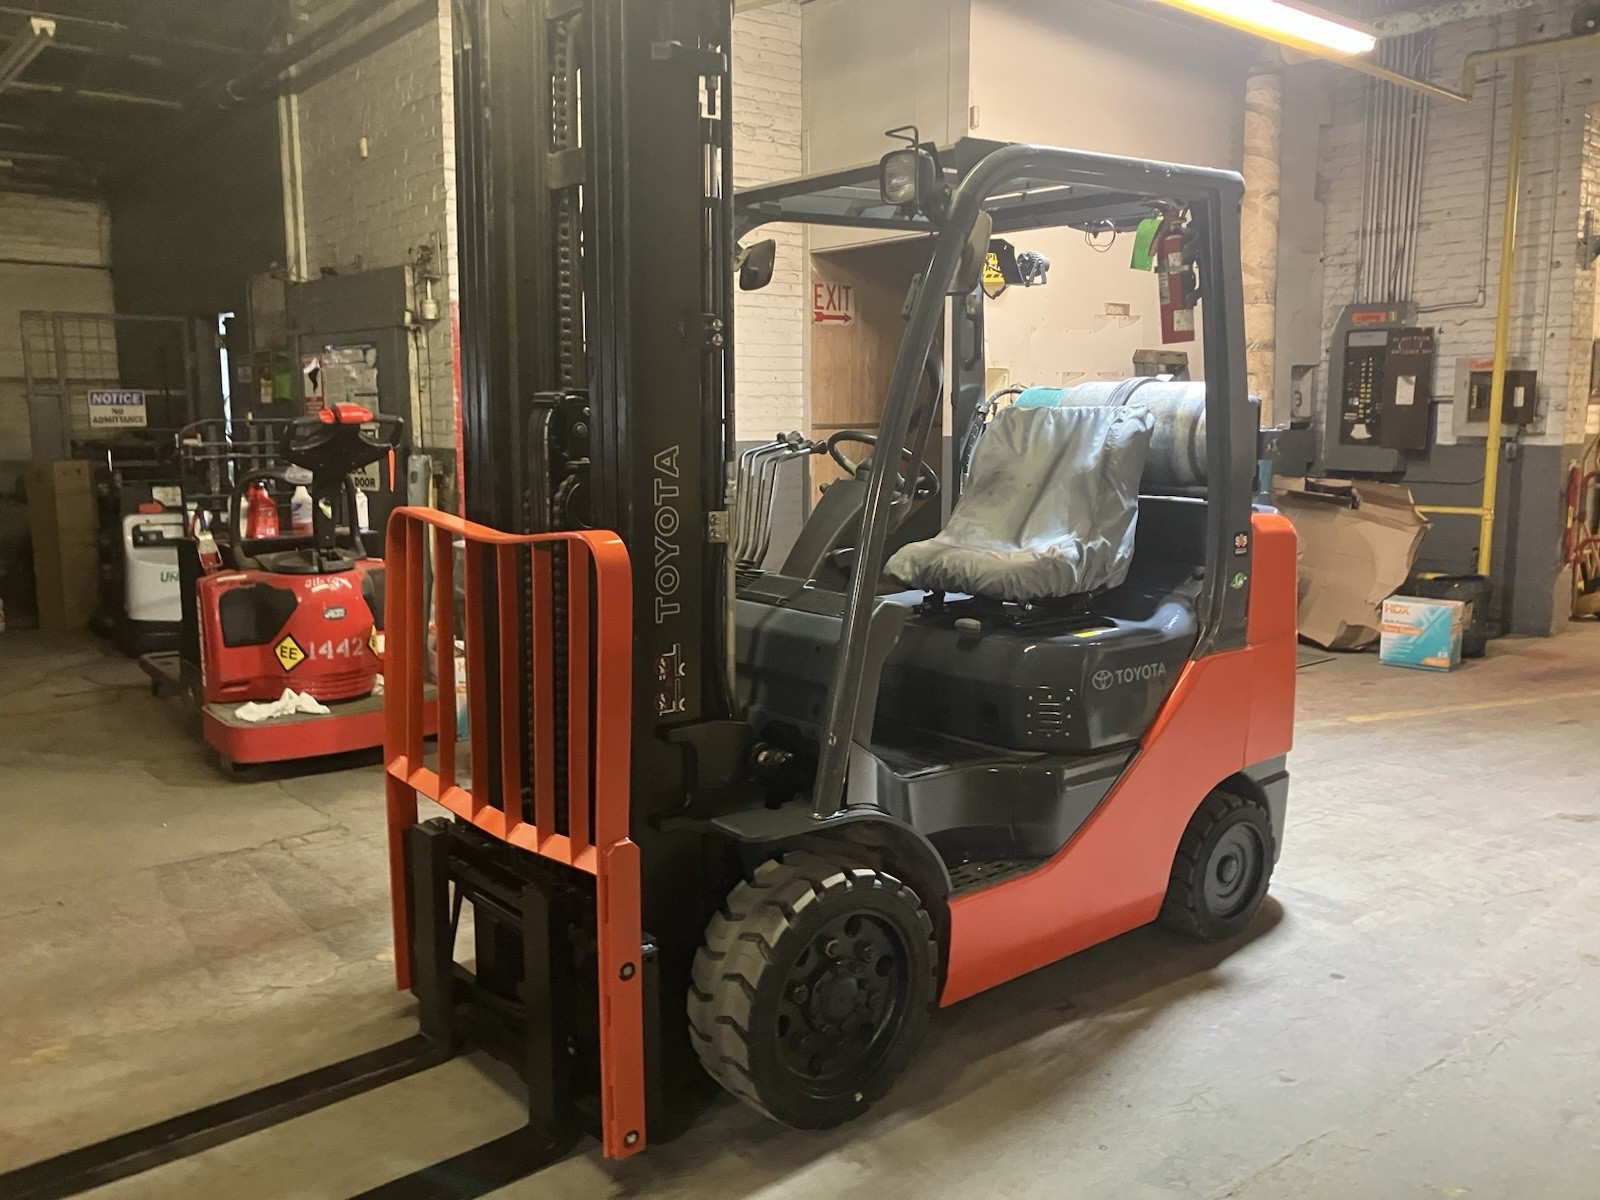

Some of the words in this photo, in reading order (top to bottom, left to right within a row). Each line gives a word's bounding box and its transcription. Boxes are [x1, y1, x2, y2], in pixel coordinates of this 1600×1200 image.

[814, 283, 852, 311] EXIT
[92, 393, 141, 405] NOTICE
[92, 415, 144, 424] ADMITTANCE
[355, 477, 376, 488] DOOR
[653, 444, 681, 624] TOYOTA
[1385, 603, 1411, 615] HDX
[280, 645, 298, 660] EE
[308, 637, 364, 661] 1442
[1115, 662, 1167, 685] TOYOTA
